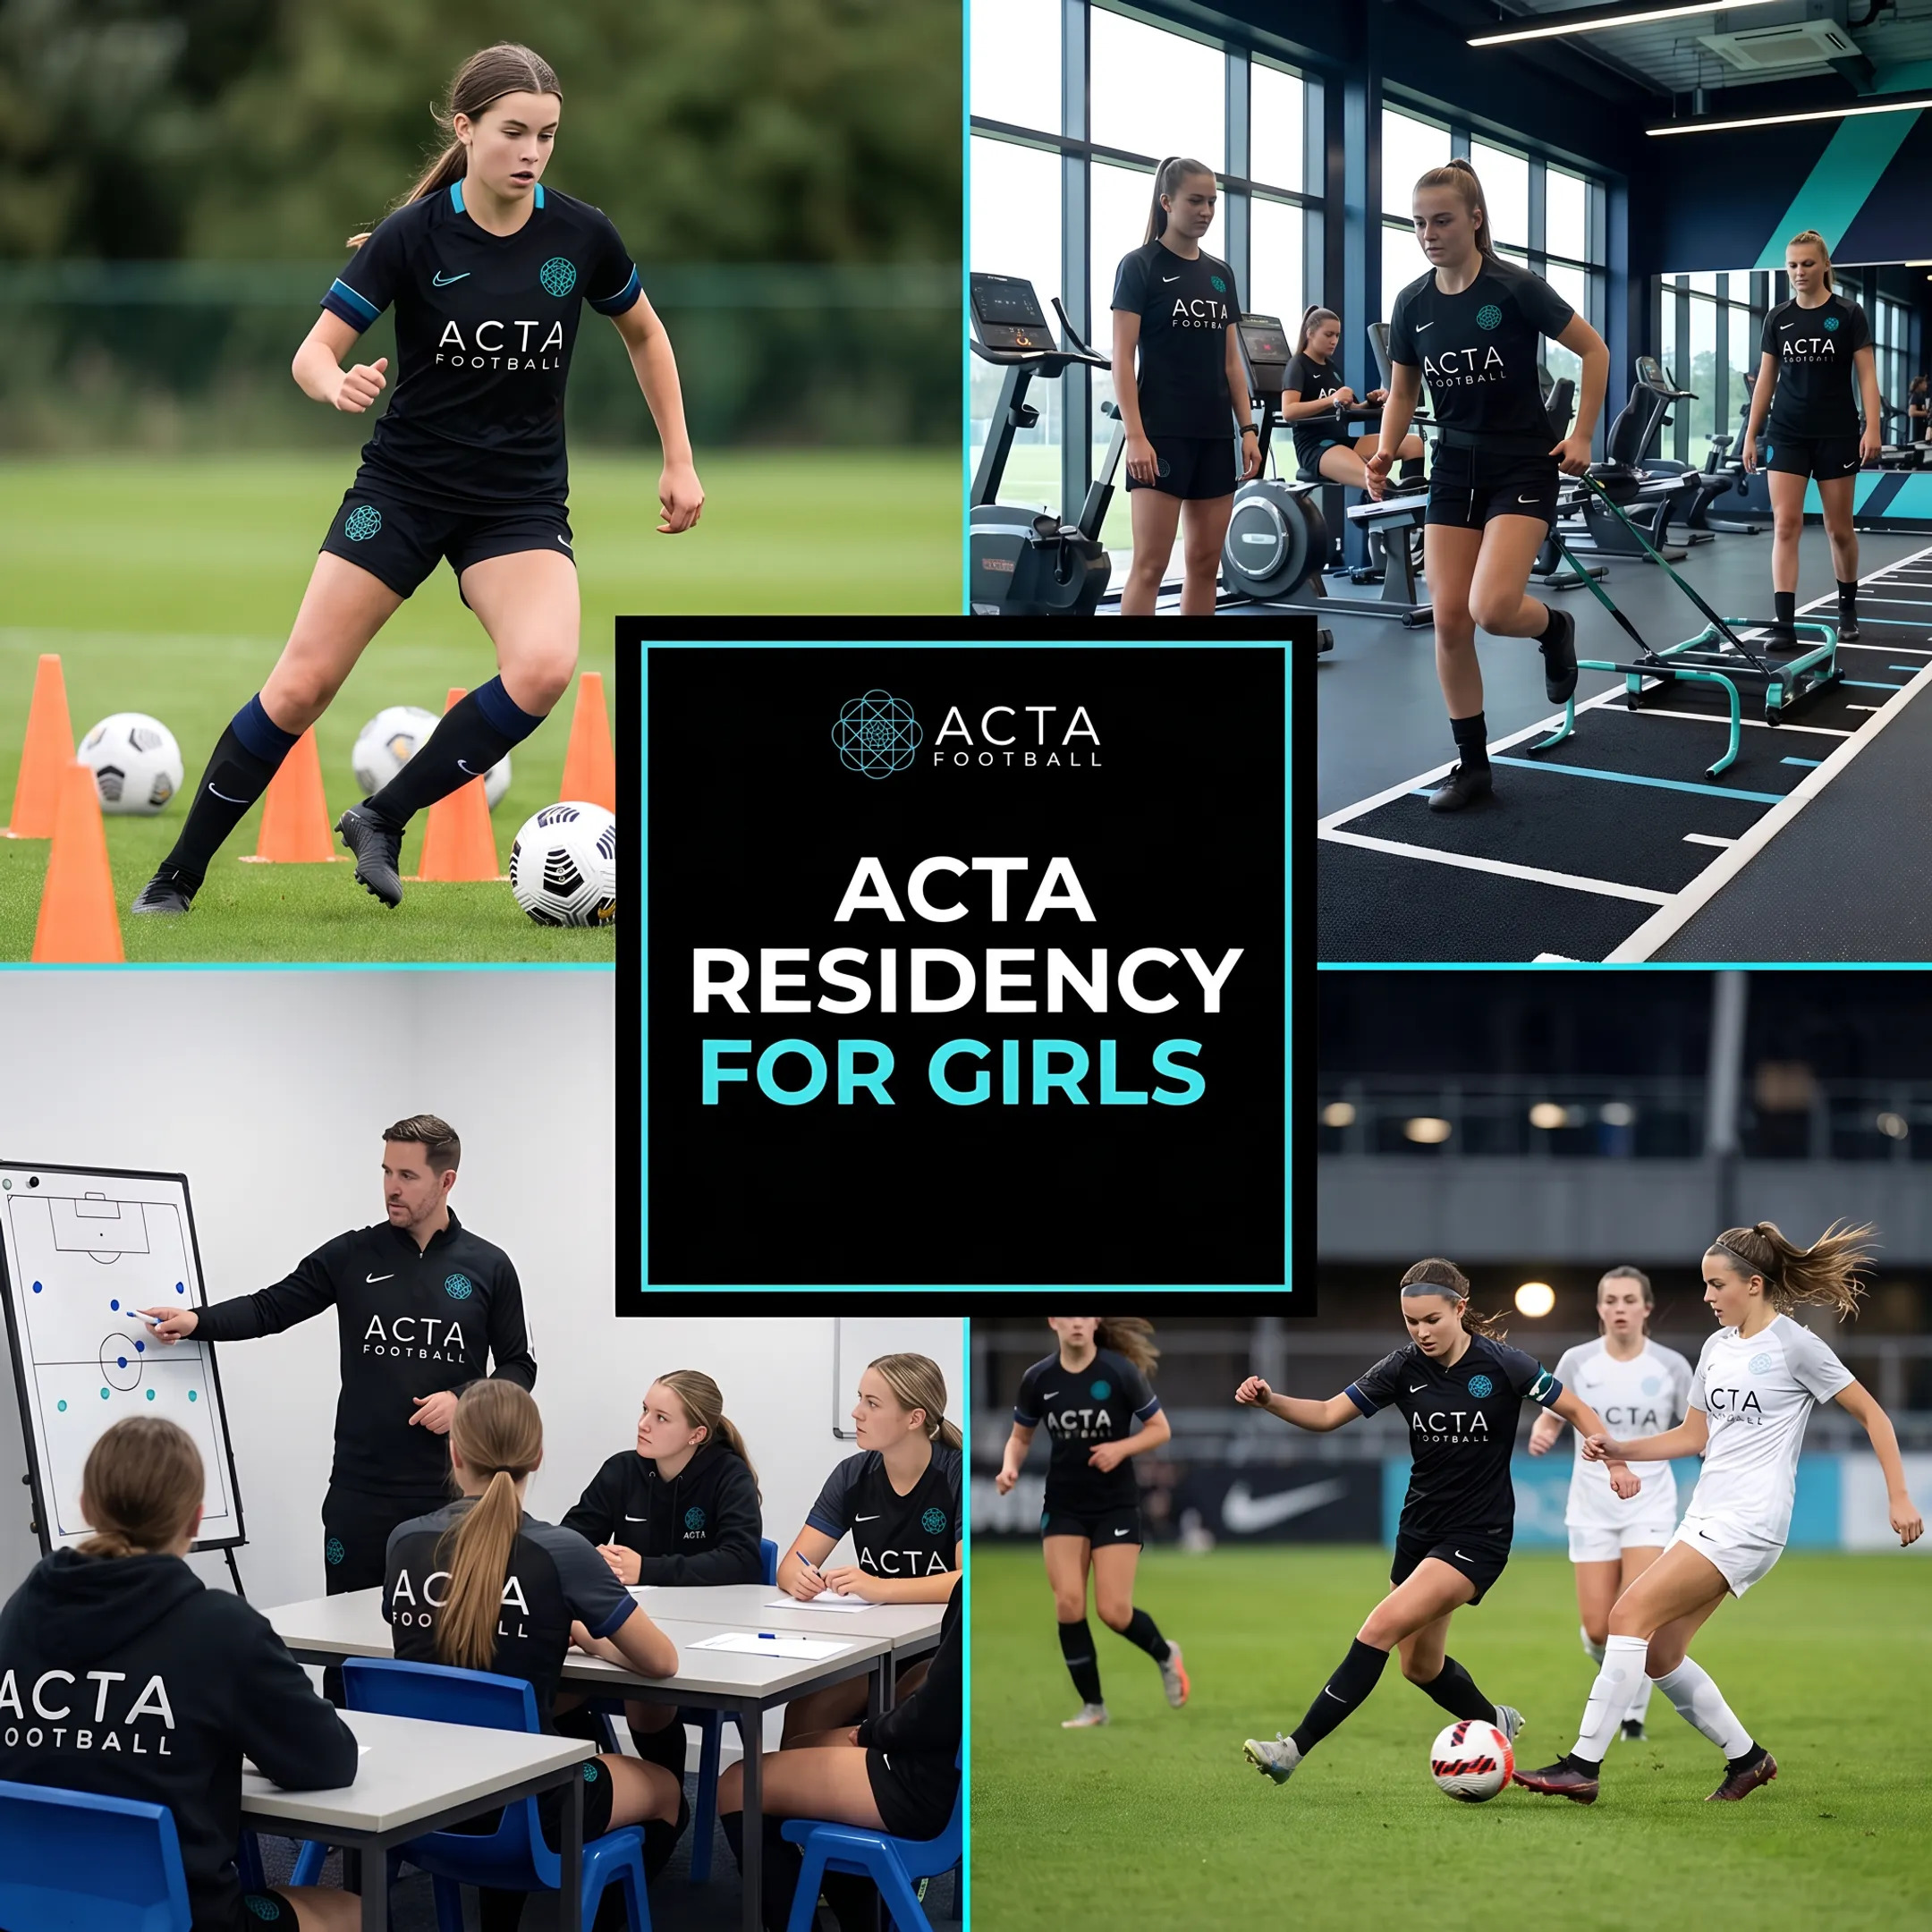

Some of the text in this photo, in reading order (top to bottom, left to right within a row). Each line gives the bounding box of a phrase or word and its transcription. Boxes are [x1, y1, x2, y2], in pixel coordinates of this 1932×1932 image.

[1173, 298, 1228, 319] ACTA
[438, 320, 563, 352] ACTA
[1173, 319, 1223, 329] FOOTBA
[1783, 338, 1835, 355] ACTA
[436, 353, 560, 370] FOOTBALL
[1424, 346, 1504, 376] ACTA
[364, 1314, 465, 1350] ACTA
[363, 1344, 465, 1363] FOOTBALL
[1704, 1388, 1762, 1413] CTA
[1047, 1409, 1112, 1429] ACTA
[1412, 1411, 1488, 1433] ACTA
[1592, 1406, 1661, 1429] CTA
[682, 1530, 706, 1539] ACTA
[860, 1546, 949, 1575] ACTA
[393, 1569, 530, 1615] ACA
[393, 1611, 528, 1638] FOOLL
[0, 1669, 175, 1730] ACTA
[4, 1726, 172, 1755] OOTBALL
